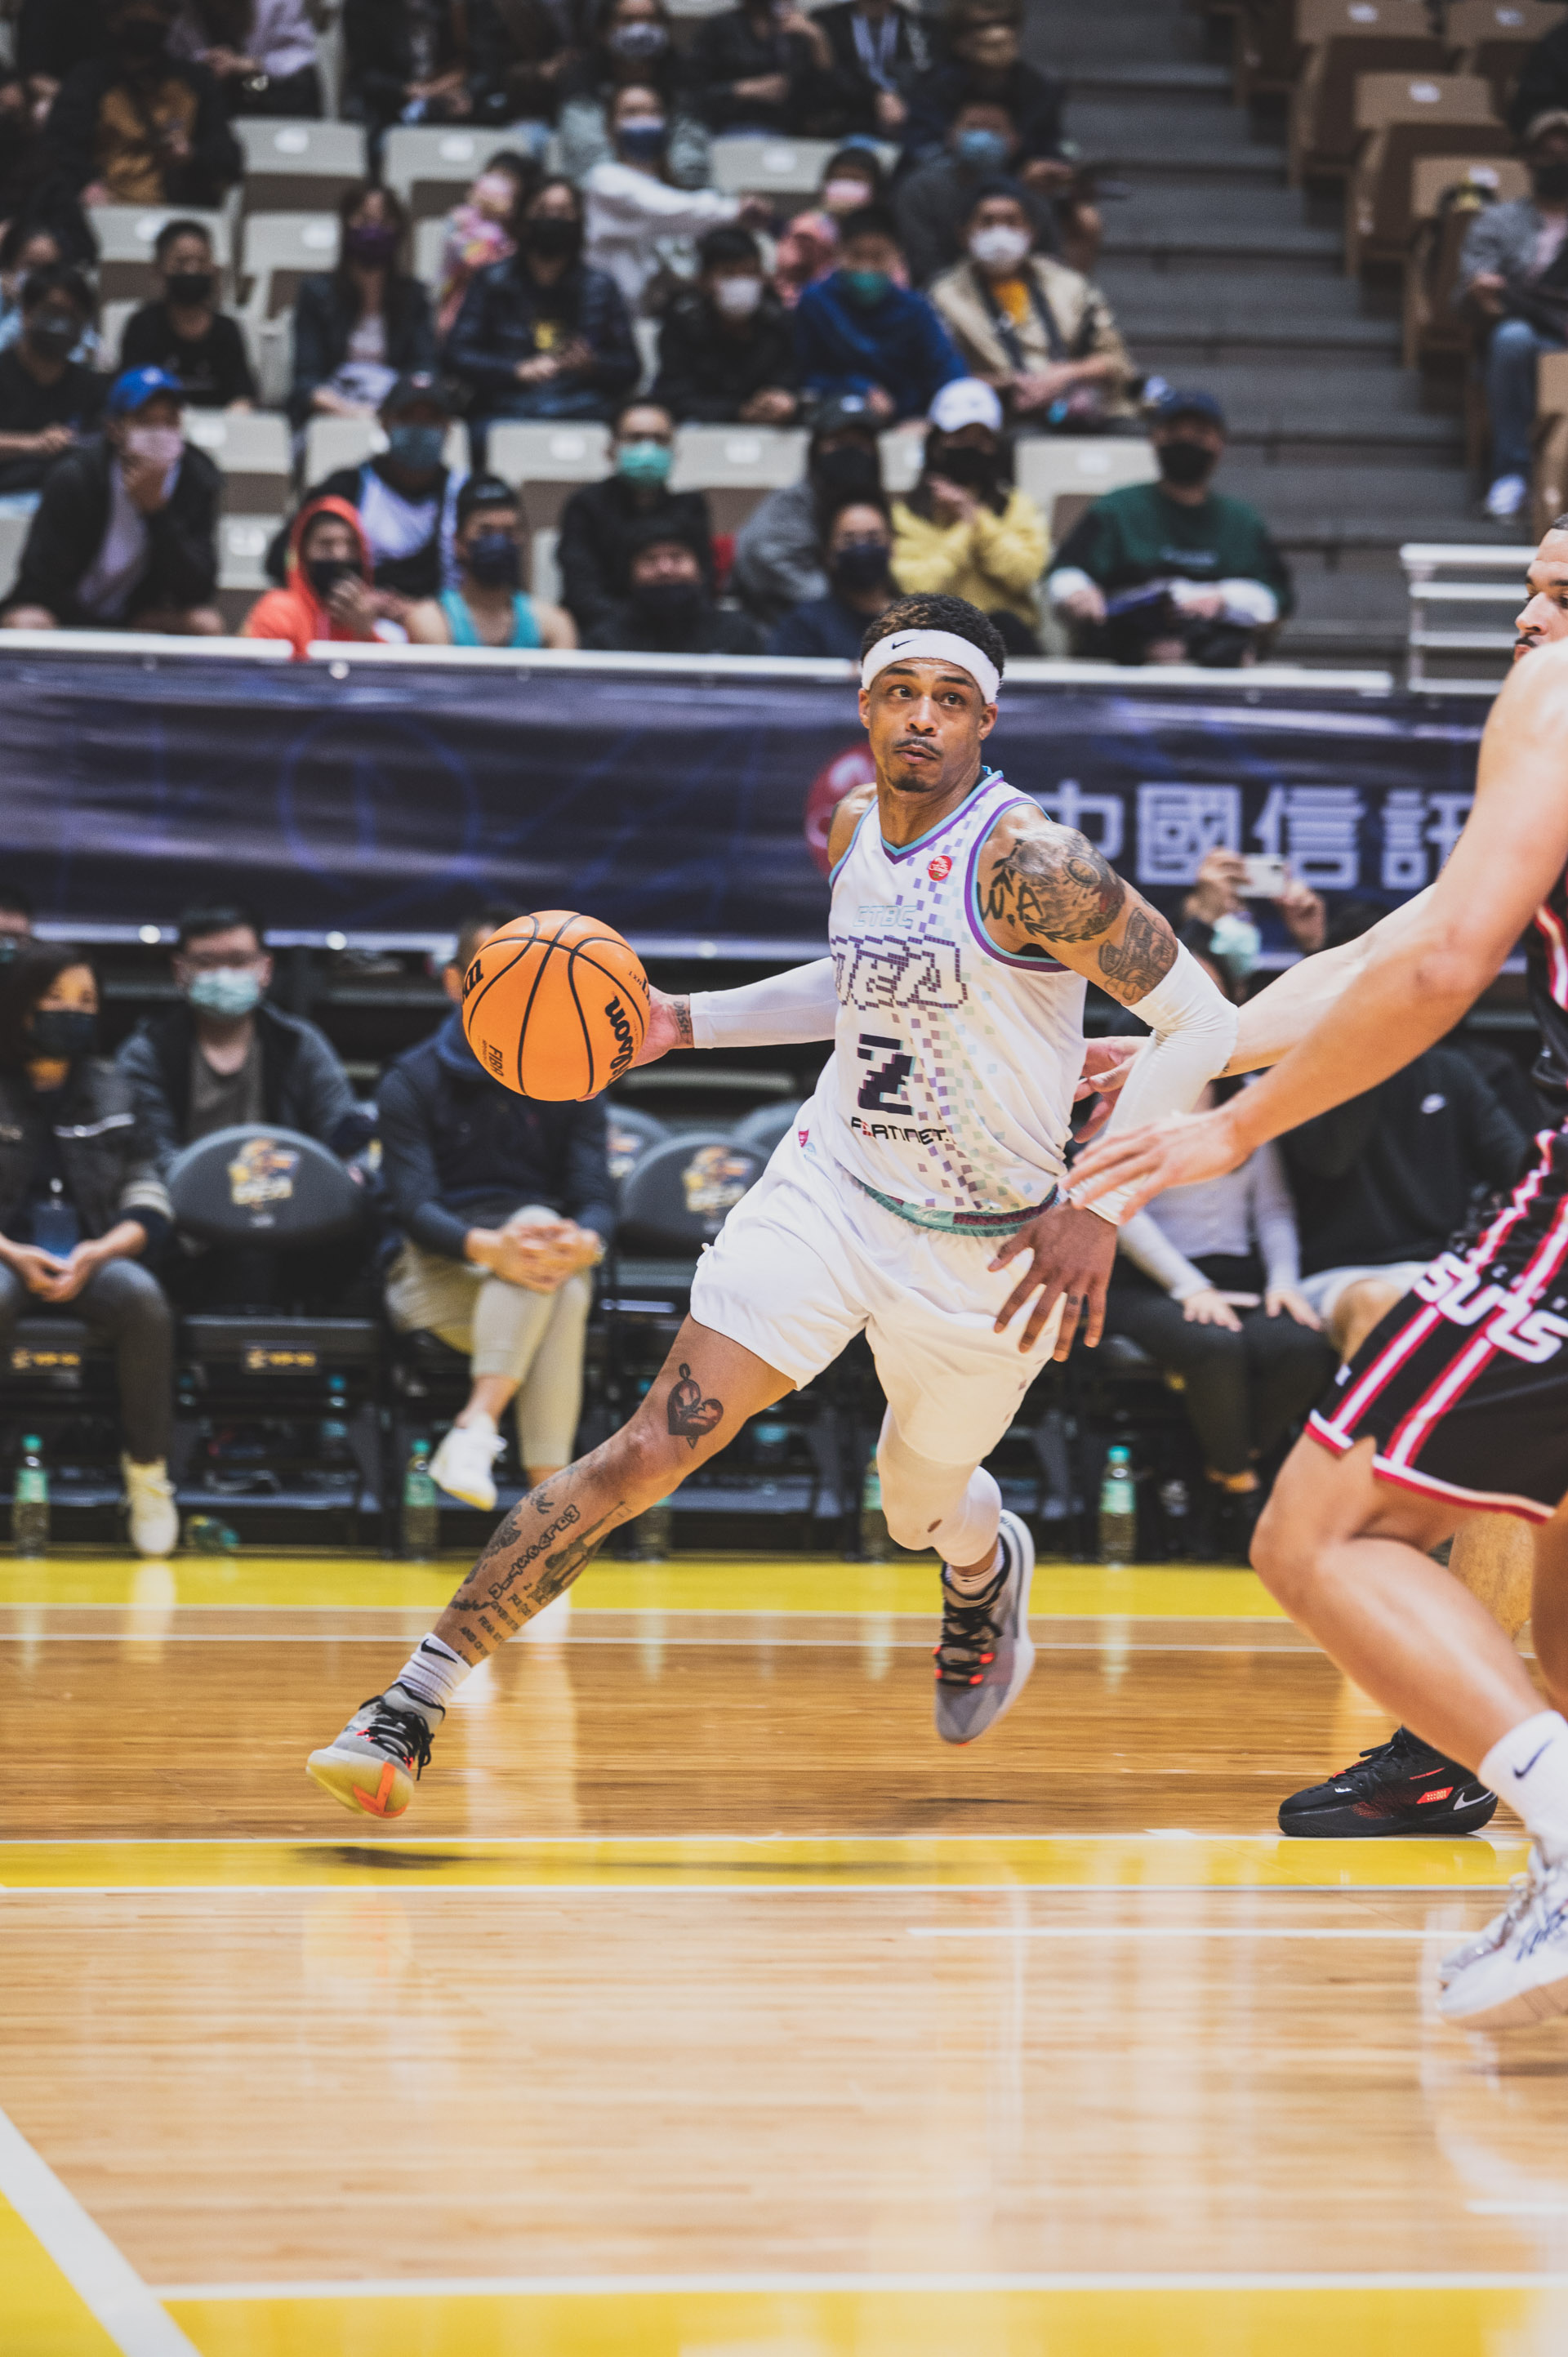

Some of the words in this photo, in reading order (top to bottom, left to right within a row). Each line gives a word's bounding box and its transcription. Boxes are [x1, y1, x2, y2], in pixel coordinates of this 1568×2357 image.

[852, 905, 917, 928] CTBC
[488, 1044, 505, 1077] FIBA
[858, 1033, 917, 1116] 2
